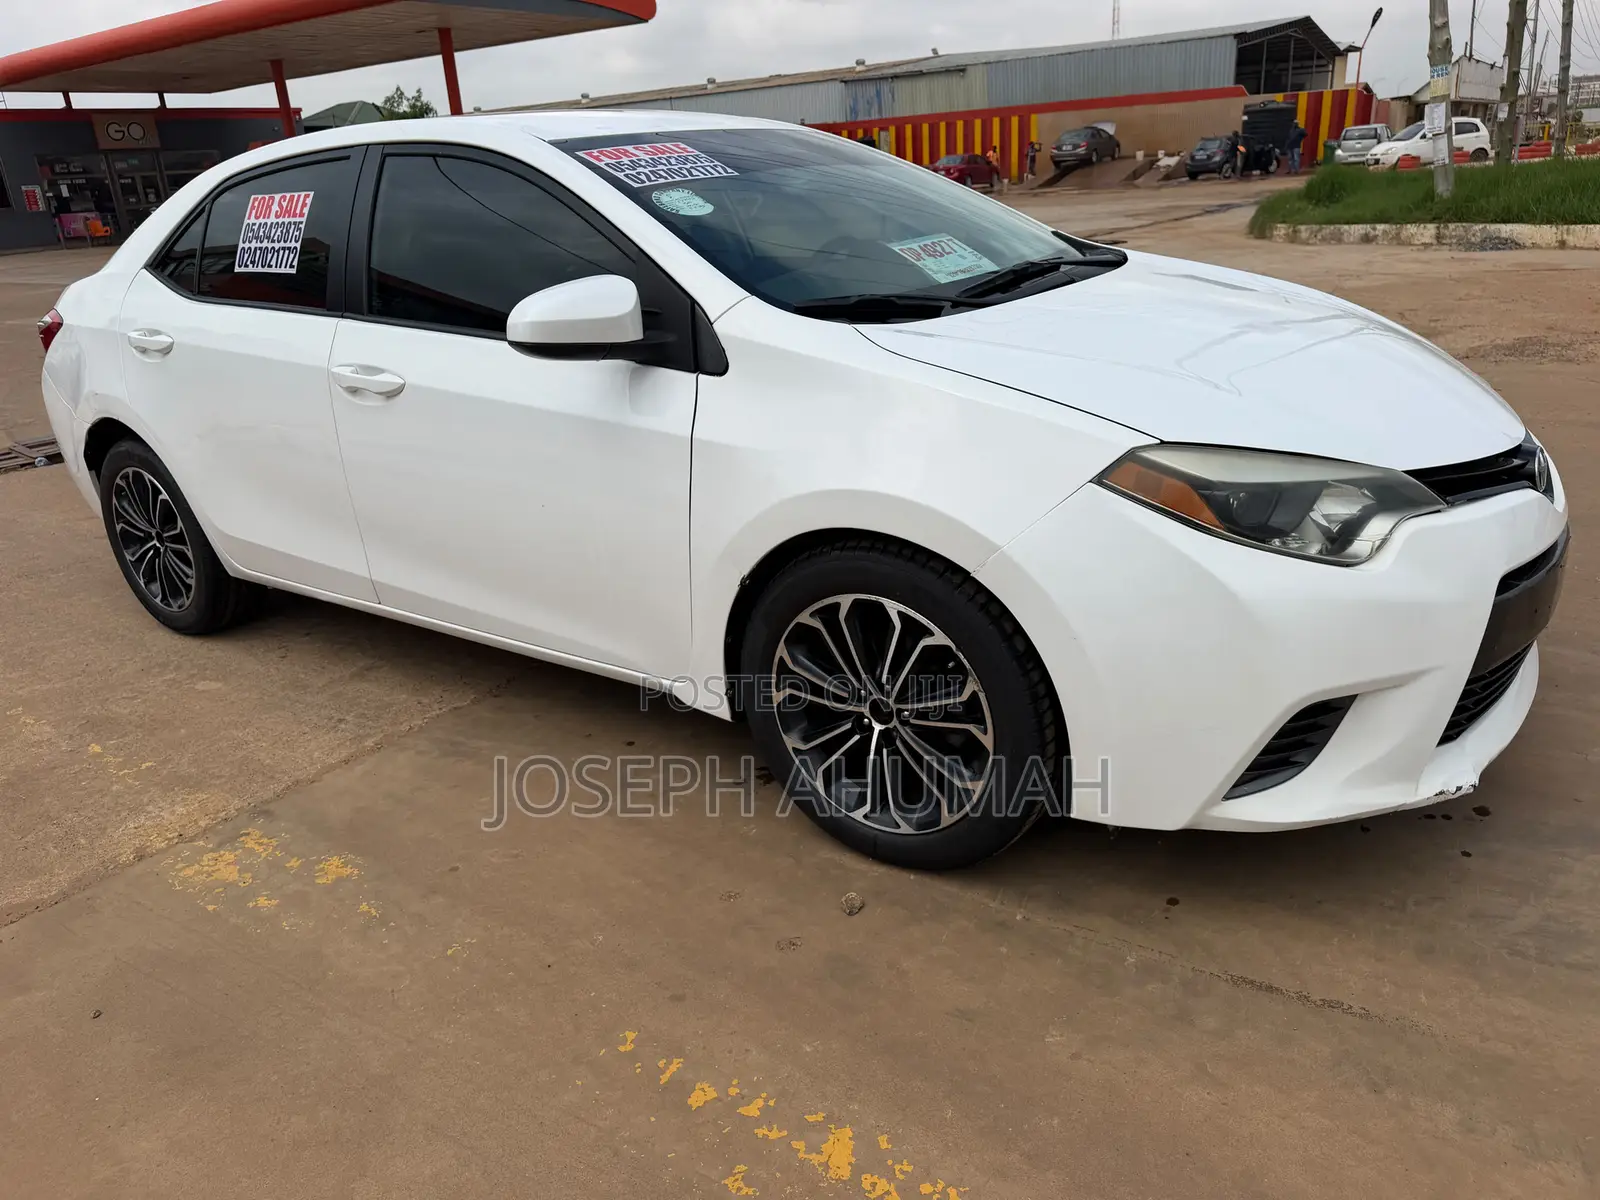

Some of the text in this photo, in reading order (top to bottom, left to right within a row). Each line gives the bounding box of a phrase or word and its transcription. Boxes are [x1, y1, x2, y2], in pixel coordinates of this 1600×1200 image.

[1431, 66, 1448, 74] OUSE
[584, 142, 697, 162] FOR SALE
[604, 153, 716, 173] 0543423875
[623, 164, 735, 185] 0247021772
[247, 193, 310, 220] FOR SALE
[242, 221, 304, 244] 0543423875
[237, 246, 298, 269] 0247021772
